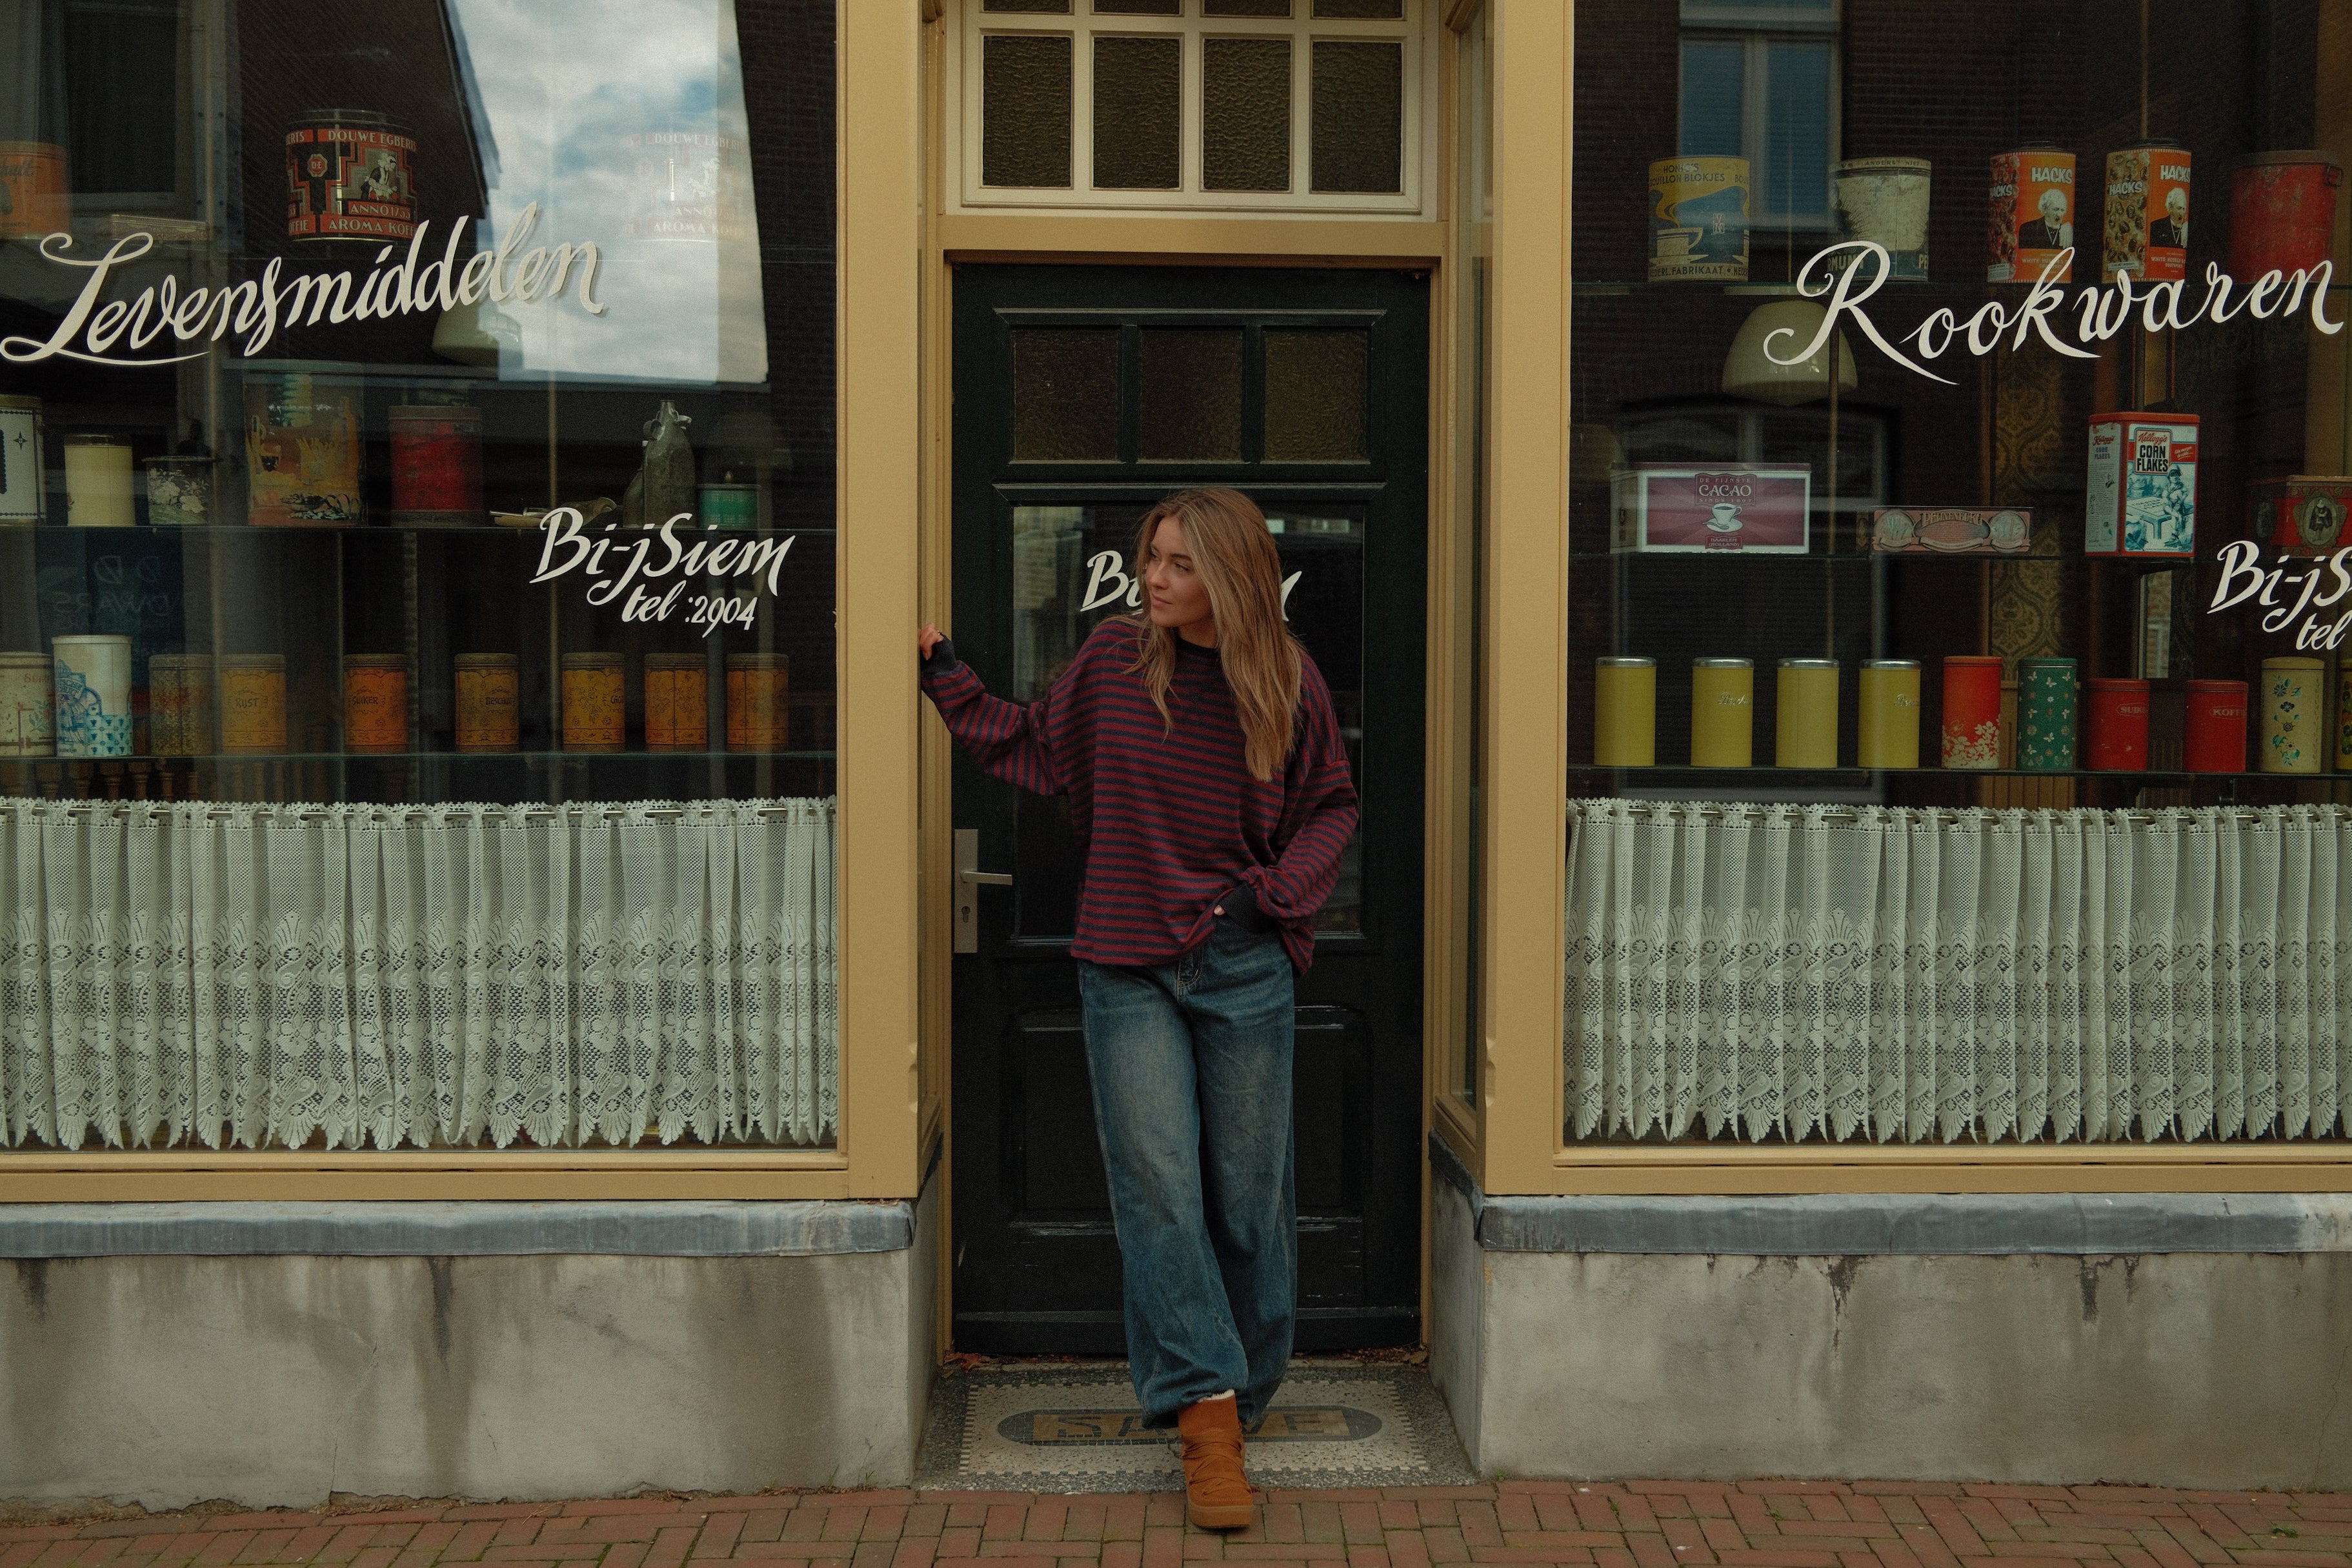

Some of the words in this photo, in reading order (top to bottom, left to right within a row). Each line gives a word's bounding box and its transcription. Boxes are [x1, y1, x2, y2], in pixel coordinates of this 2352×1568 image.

[328, 130, 377, 143] DOUWE
[380, 134, 417, 152] EGBERTS
[654, 132, 699, 145] DOUWE
[1684, 173, 1725, 182] BLOKJES
[2031, 166, 2073, 185] HACKS
[2109, 181, 2143, 196] HACKS
[350, 205, 390, 217] ANNO
[328, 219, 383, 232] AROMA
[653, 223, 706, 233] AROMA
[1672, 266, 1724, 276] FABRIKAAT
[0, 201, 605, 366] Levensmiddelen
[1763, 240, 2345, 386] Rookwaren
[2138, 432, 2167, 445] Kellogg's
[2140, 445, 2166, 459] CORN
[2136, 457, 2168, 472] FLAKES
[1698, 485, 1752, 497] CACAO
[621, 579, 687, 623] tel
[1057, 1413, 1325, 1439] SAVE
